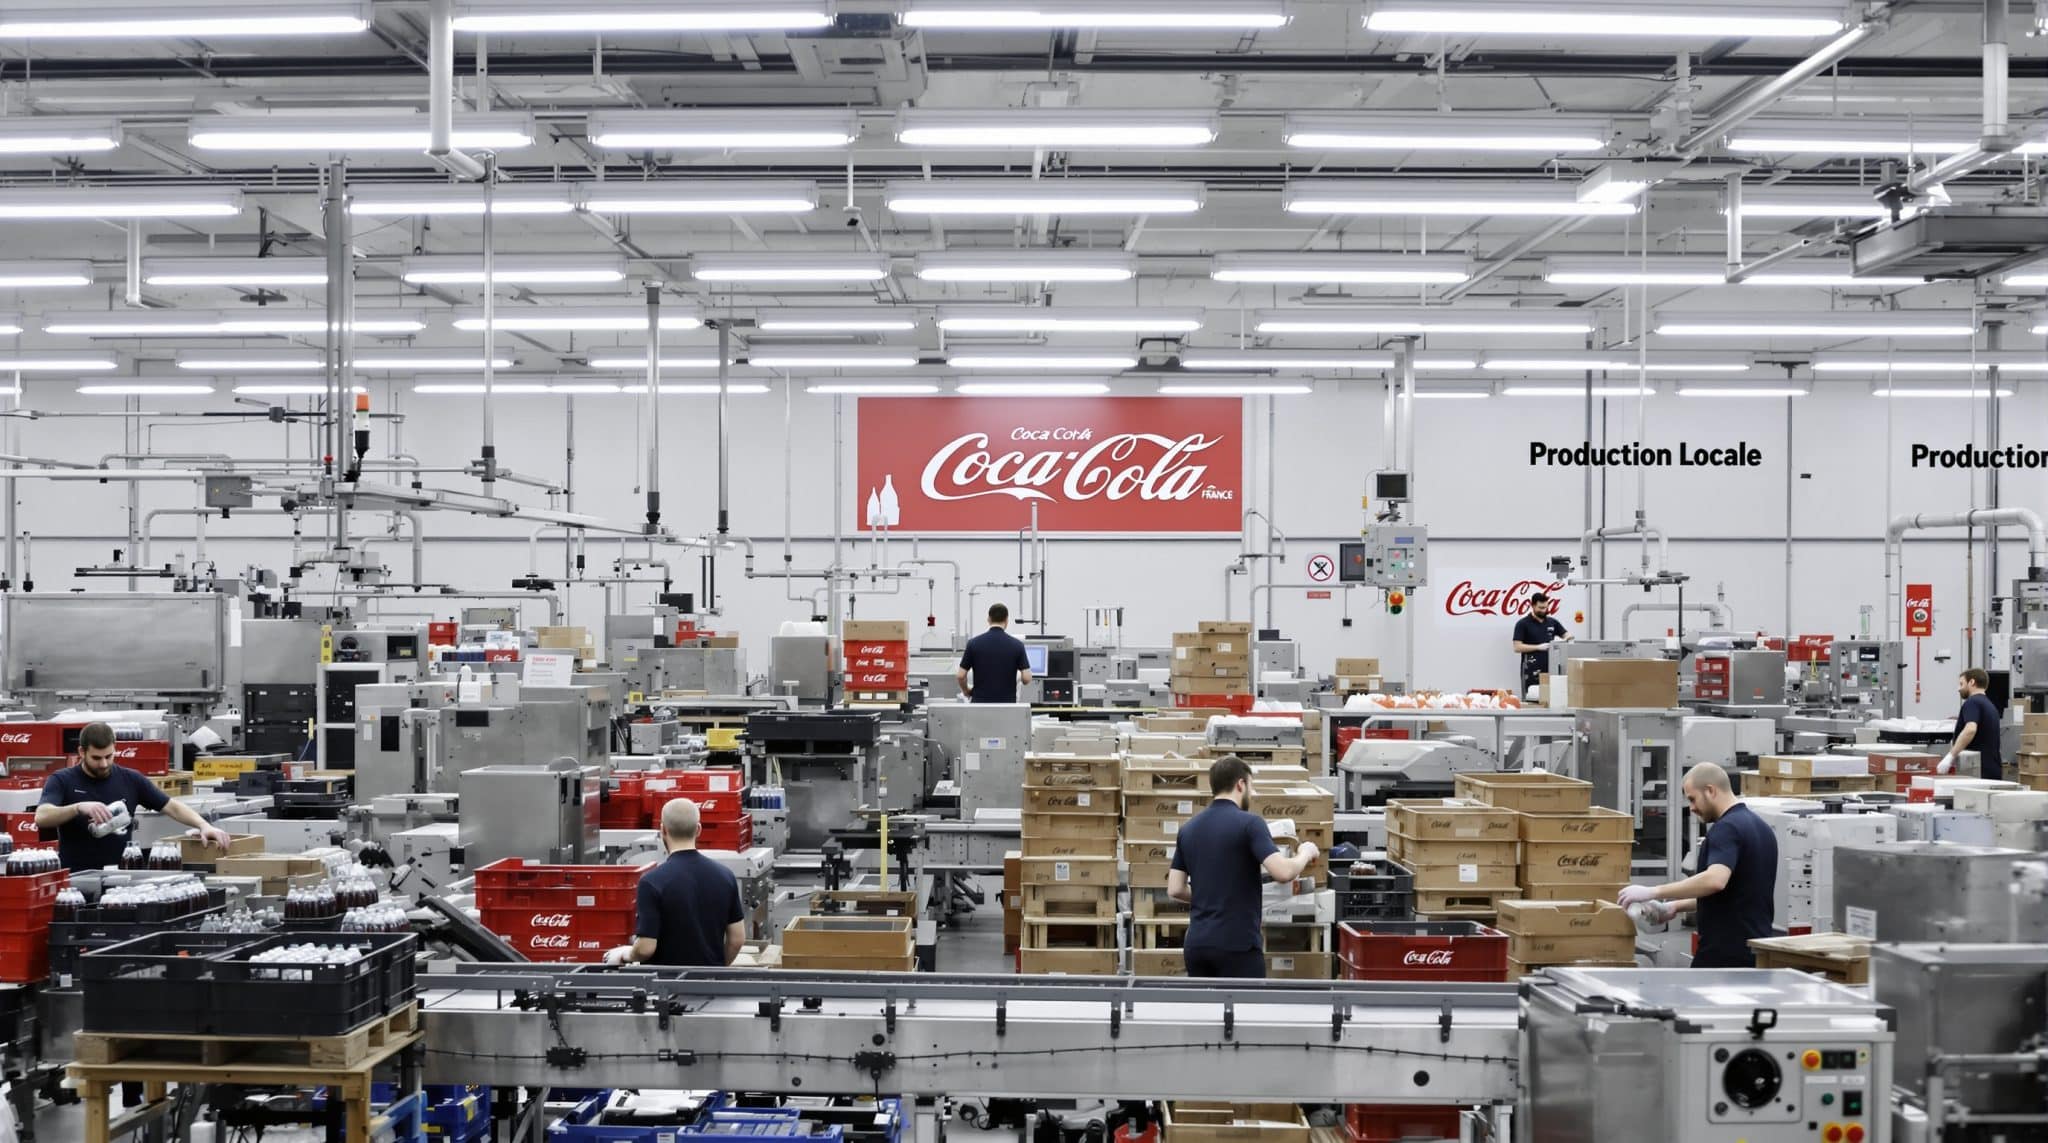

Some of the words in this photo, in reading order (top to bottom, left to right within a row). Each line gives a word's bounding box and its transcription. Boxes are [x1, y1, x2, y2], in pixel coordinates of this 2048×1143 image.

[1011, 427, 1050, 441] Coca
[1529, 441, 1672, 466] Production
[1679, 441, 1763, 466] Locale
[1201, 489, 1233, 500] FRANCE
